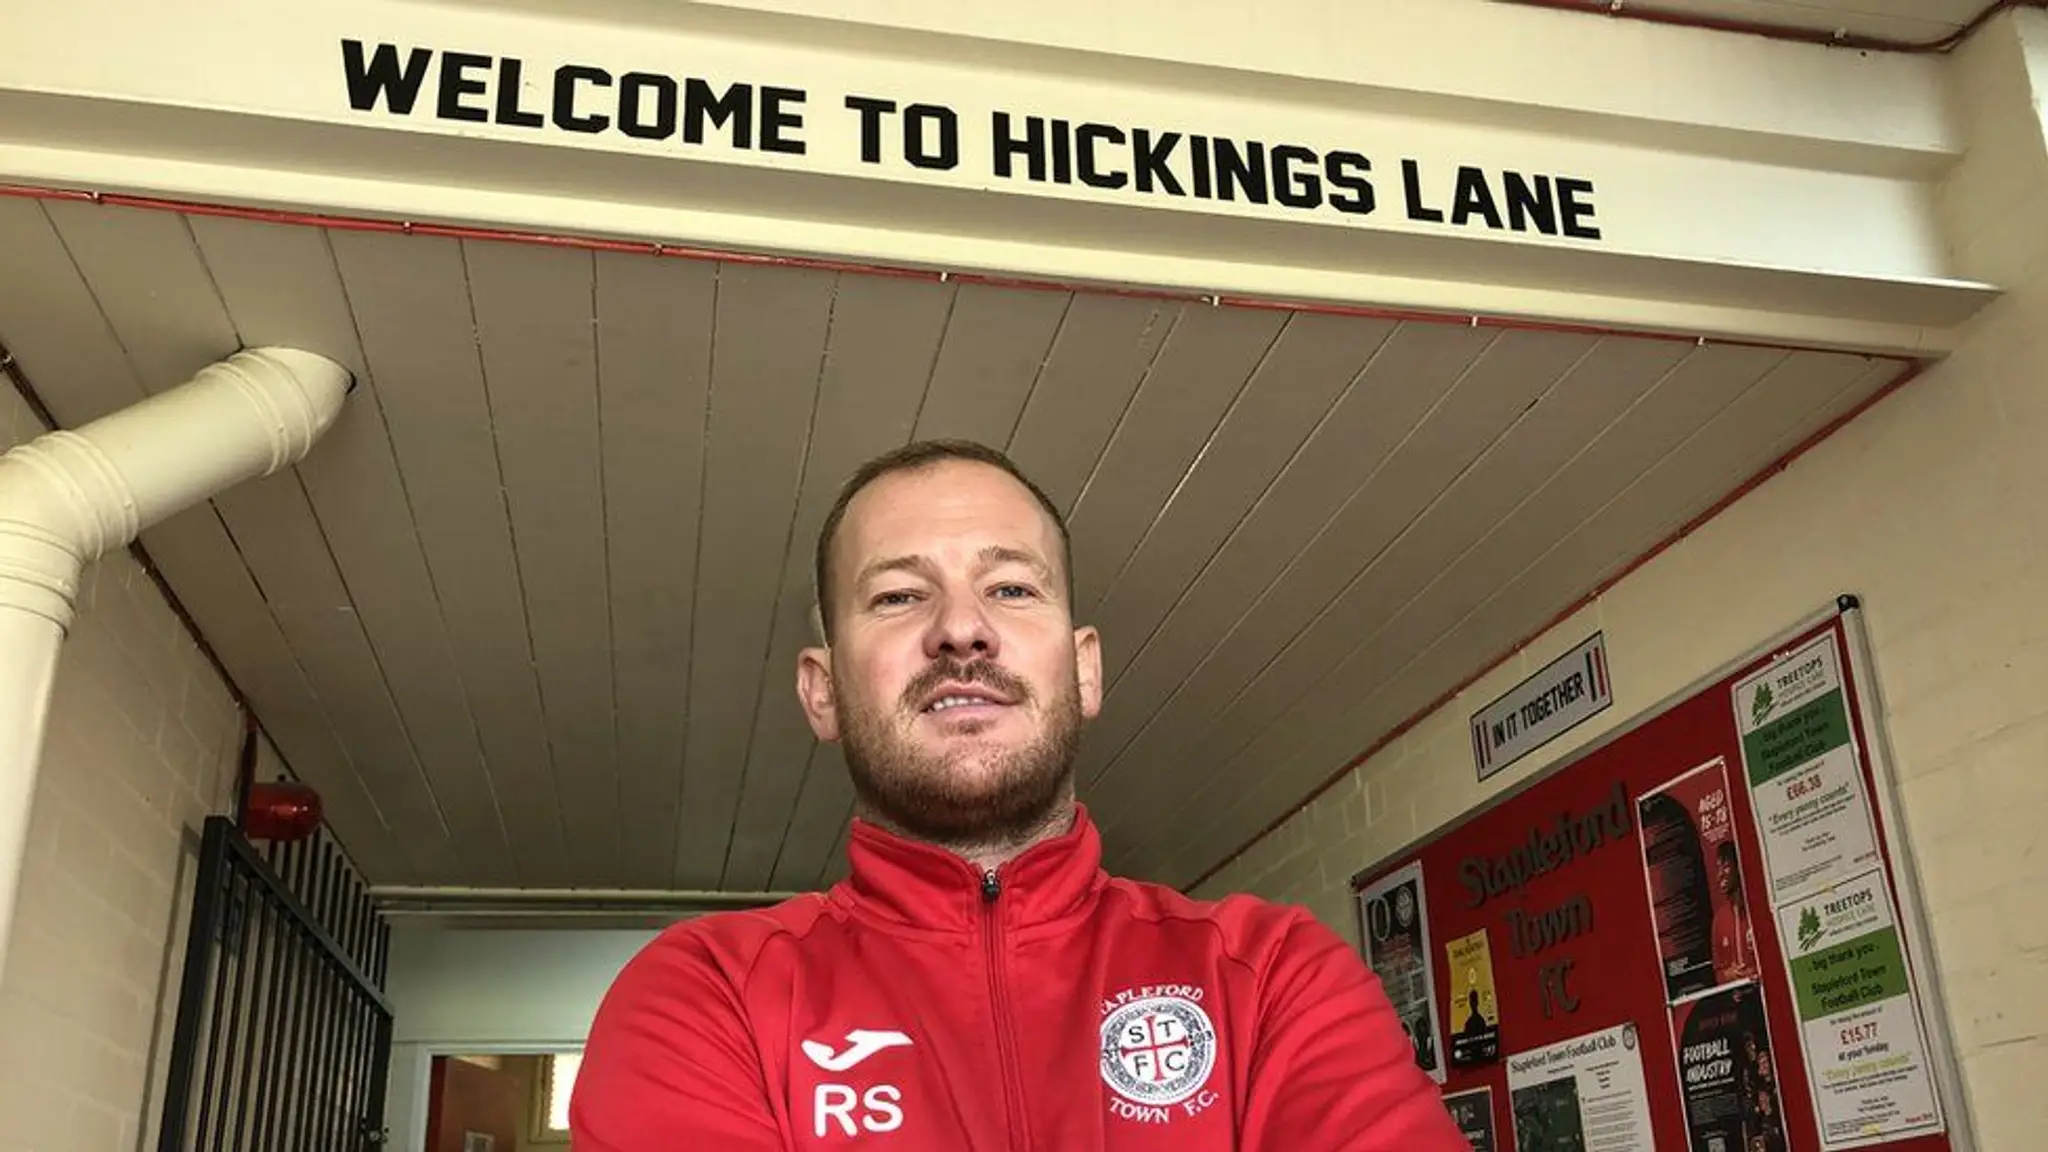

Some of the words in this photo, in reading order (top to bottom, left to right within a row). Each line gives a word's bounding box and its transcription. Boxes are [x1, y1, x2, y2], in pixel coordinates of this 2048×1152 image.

[341, 39, 806, 155] WELCOME
[845, 96, 958, 171] TO
[991, 111, 1376, 215] HICKINGS
[1402, 159, 1602, 240] LANE
[1776, 655, 1823, 688] TREETOPS
[1492, 720, 1506, 749] IN
[1505, 712, 1518, 740] IT
[1520, 671, 1585, 731] TOGETHER
[1457, 780, 1632, 908] Stapleford
[1823, 888, 1873, 916] TREETOPS
[1507, 894, 1593, 958] Town
[1539, 957, 1581, 1018] FC
[1811, 972, 1858, 996] Stapleford
[1859, 965, 1888, 980] Town
[1821, 989, 1859, 1009] Football
[1860, 983, 1884, 1000] Club
[1100, 984, 1204, 1015] APLEFORD
[1128, 1026, 1145, 1044] S
[1156, 1019, 1177, 1038] T
[1598, 1033, 1617, 1050] Club
[1840, 1021, 1877, 1045] £15.77
[1133, 1055, 1149, 1077] F
[1165, 1050, 1185, 1071] C
[1683, 1038, 1731, 1064] FOOTBALL
[1685, 1058, 1733, 1084] INDUSTRY
[814, 1084, 904, 1138] RS
[1110, 1096, 1171, 1124] TOWN
[1183, 1089, 1219, 1117] F.C.
